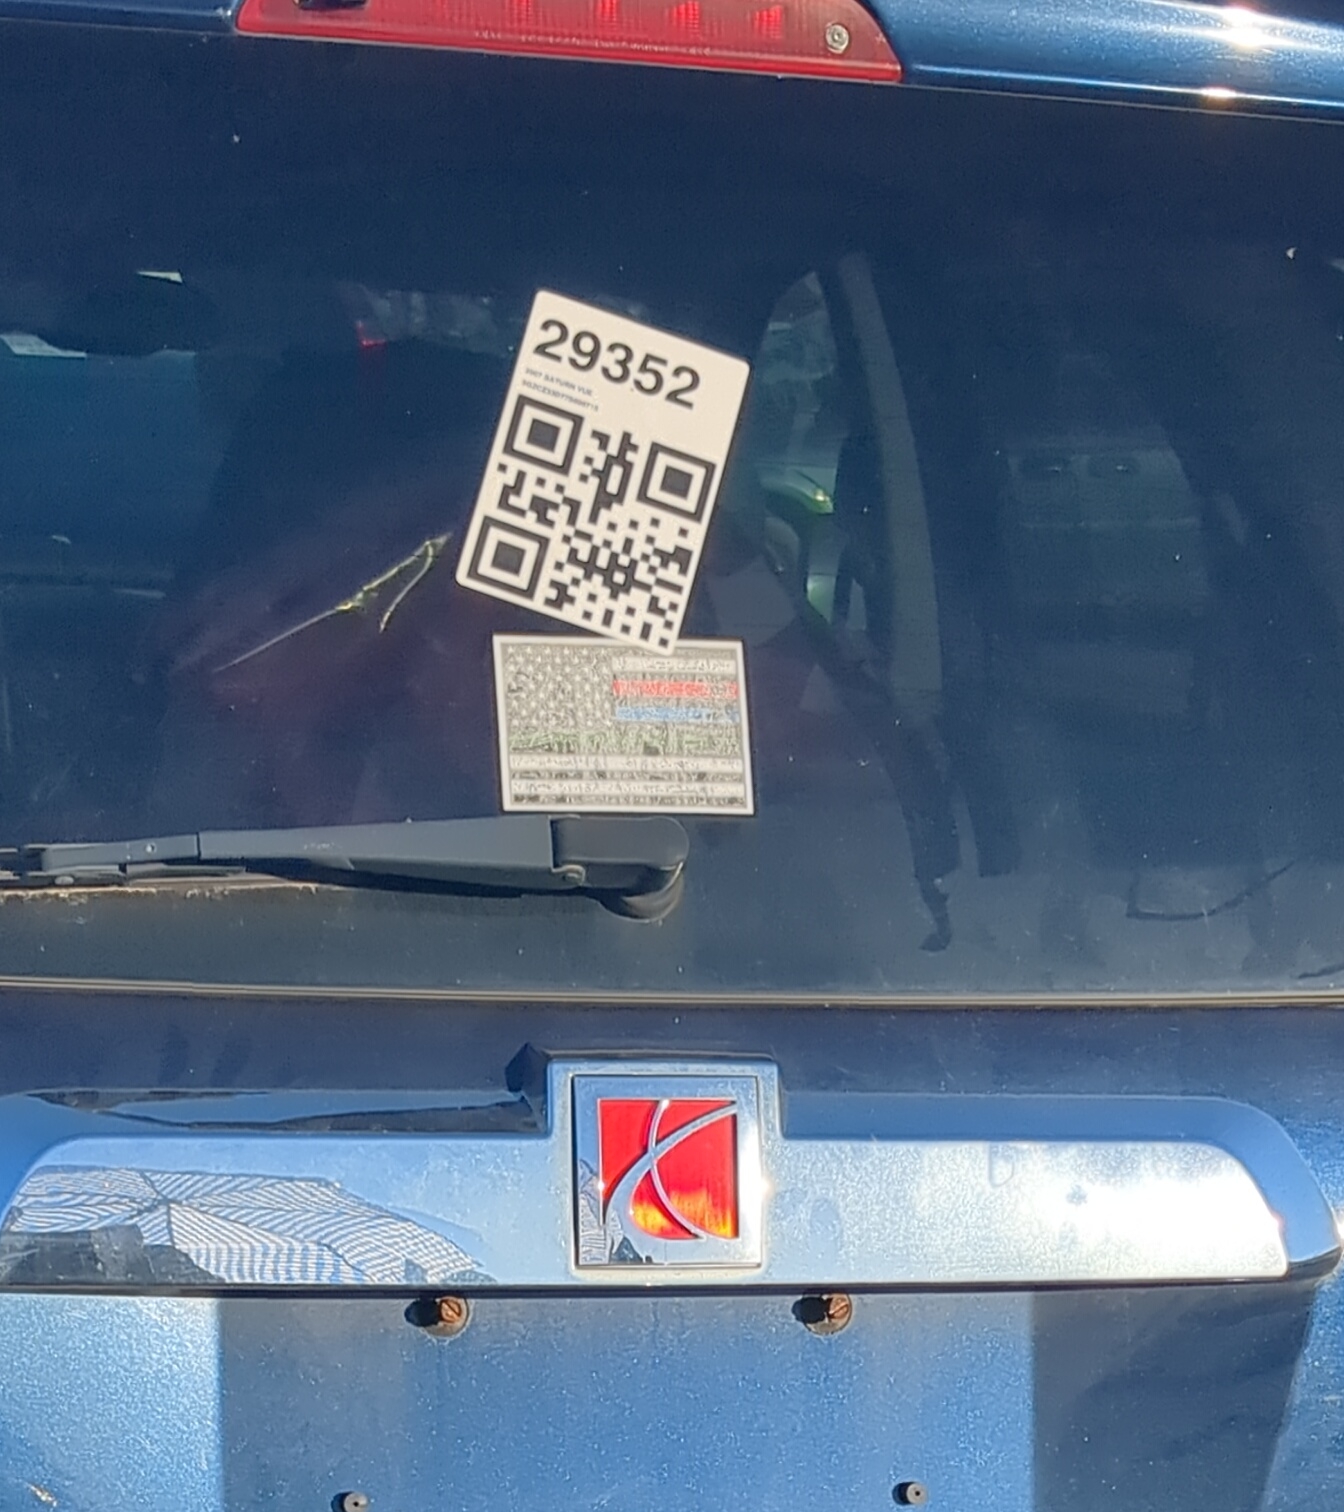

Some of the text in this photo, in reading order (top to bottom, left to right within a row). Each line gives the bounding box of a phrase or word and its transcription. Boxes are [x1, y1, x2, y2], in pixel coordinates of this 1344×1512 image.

[533, 319, 700, 410] 29352
[543, 373, 576, 391] SATURN
[577, 385, 593, 396] VUE
